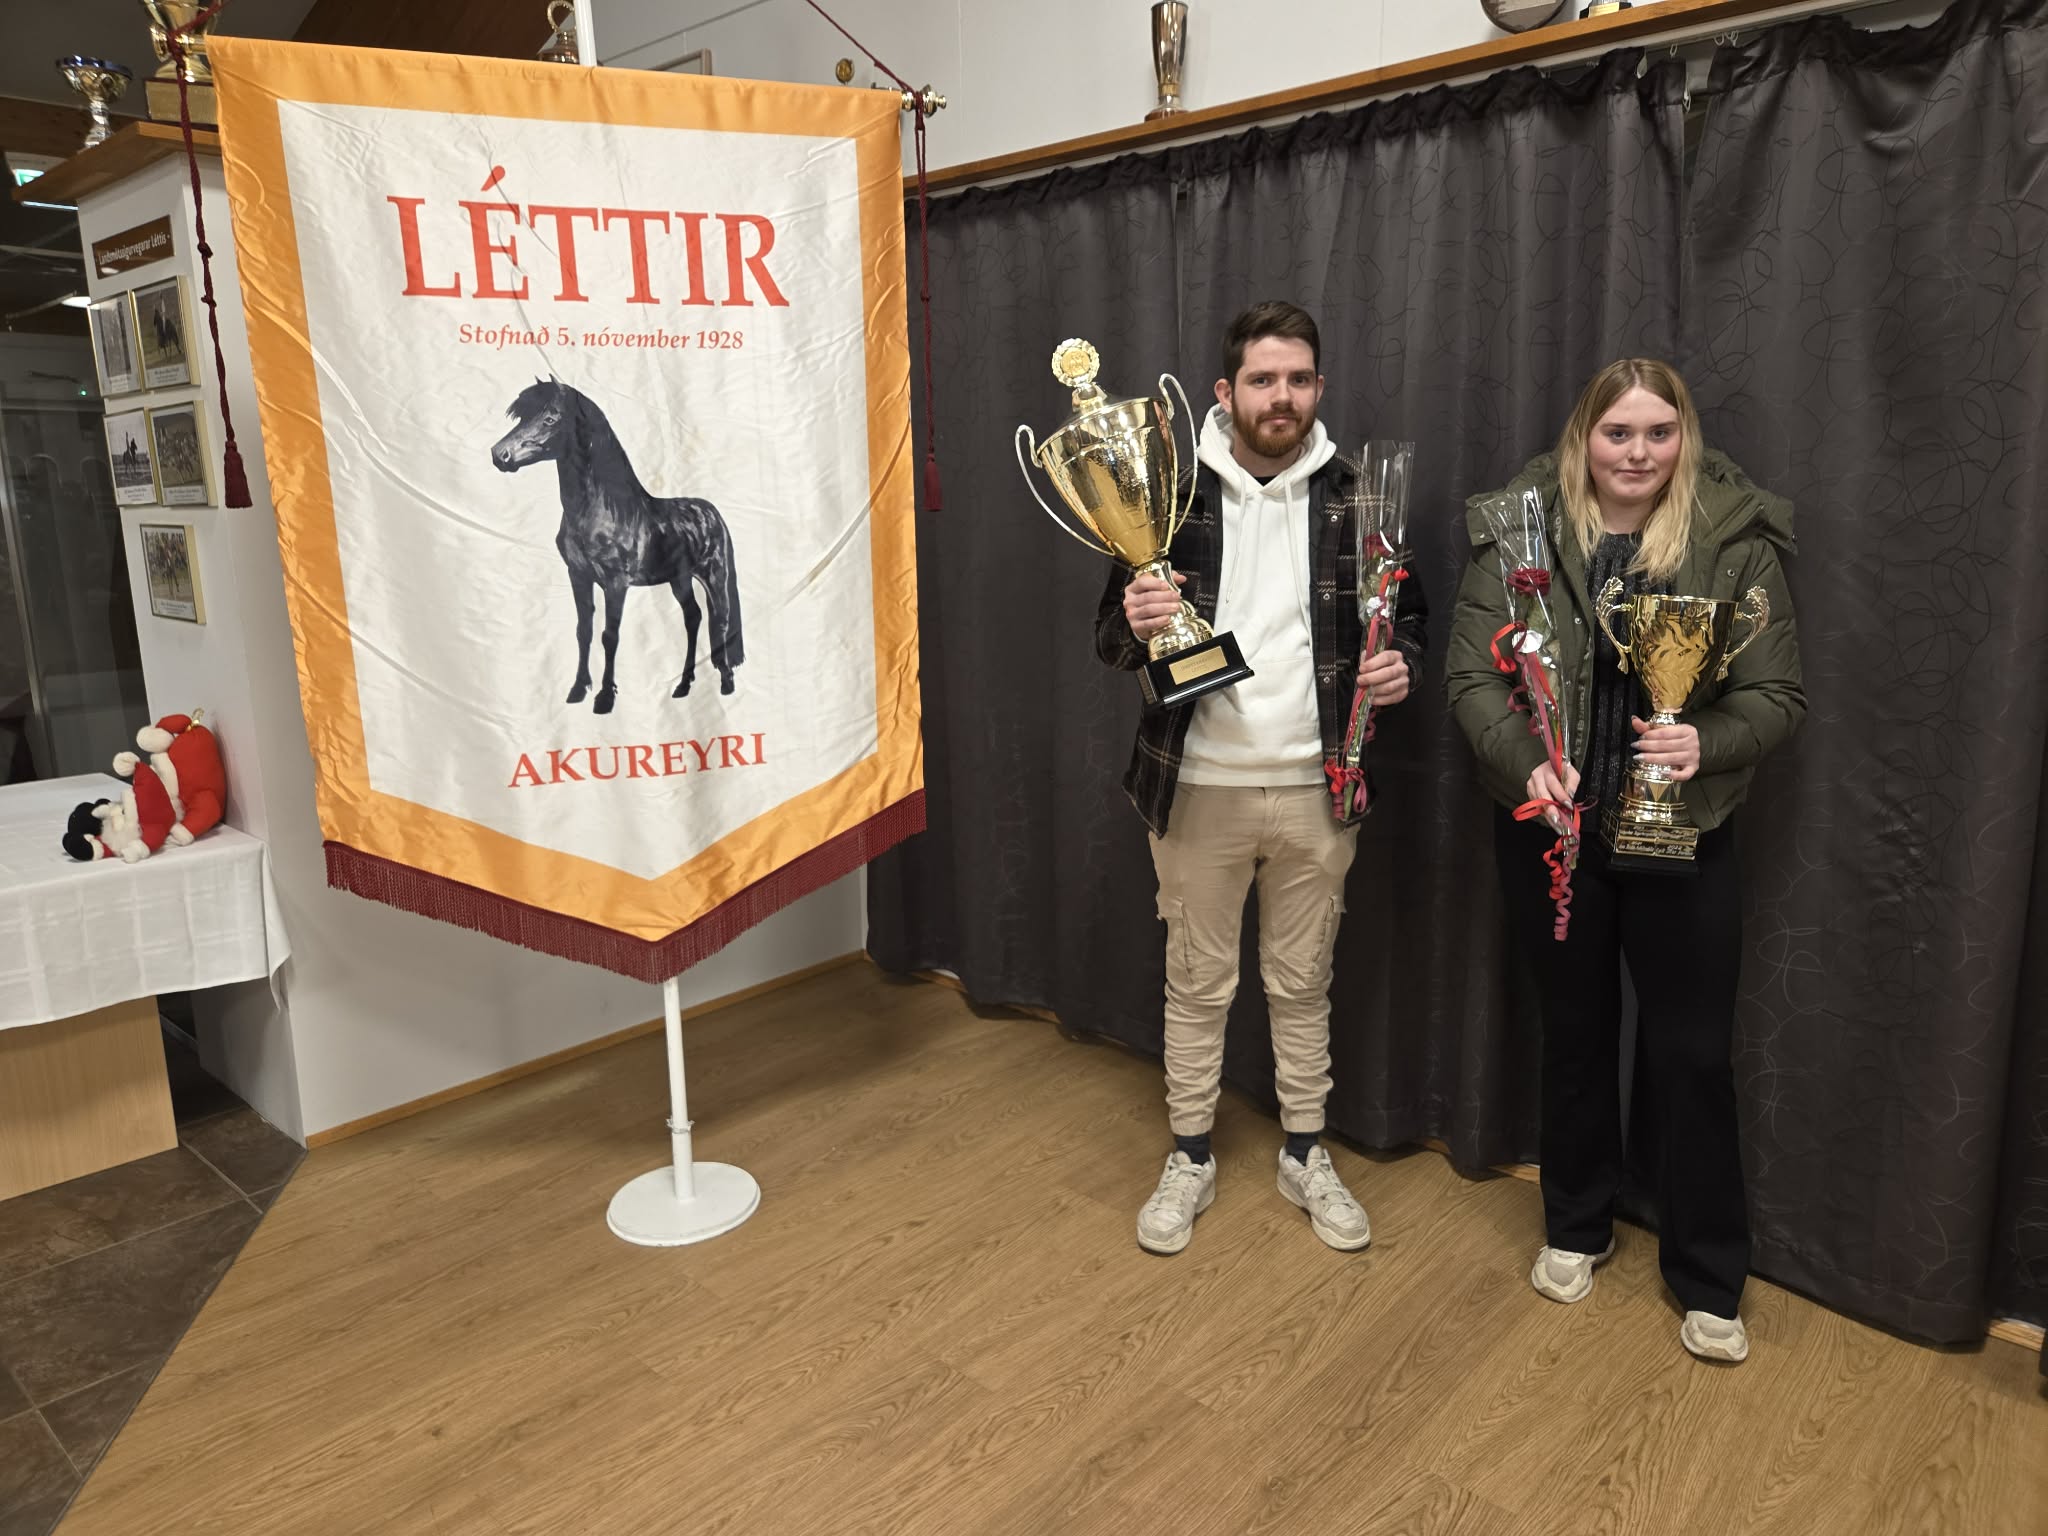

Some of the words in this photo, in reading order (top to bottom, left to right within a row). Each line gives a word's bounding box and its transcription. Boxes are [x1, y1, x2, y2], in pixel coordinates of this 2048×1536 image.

[387, 165, 790, 307] LÉTTIR
[459, 324, 550, 350] Stofnað
[556, 327, 576, 347] 5.
[583, 326, 690, 349] nóvember
[696, 330, 744, 349] 1928
[508, 733, 767, 788] AKUREYRI
